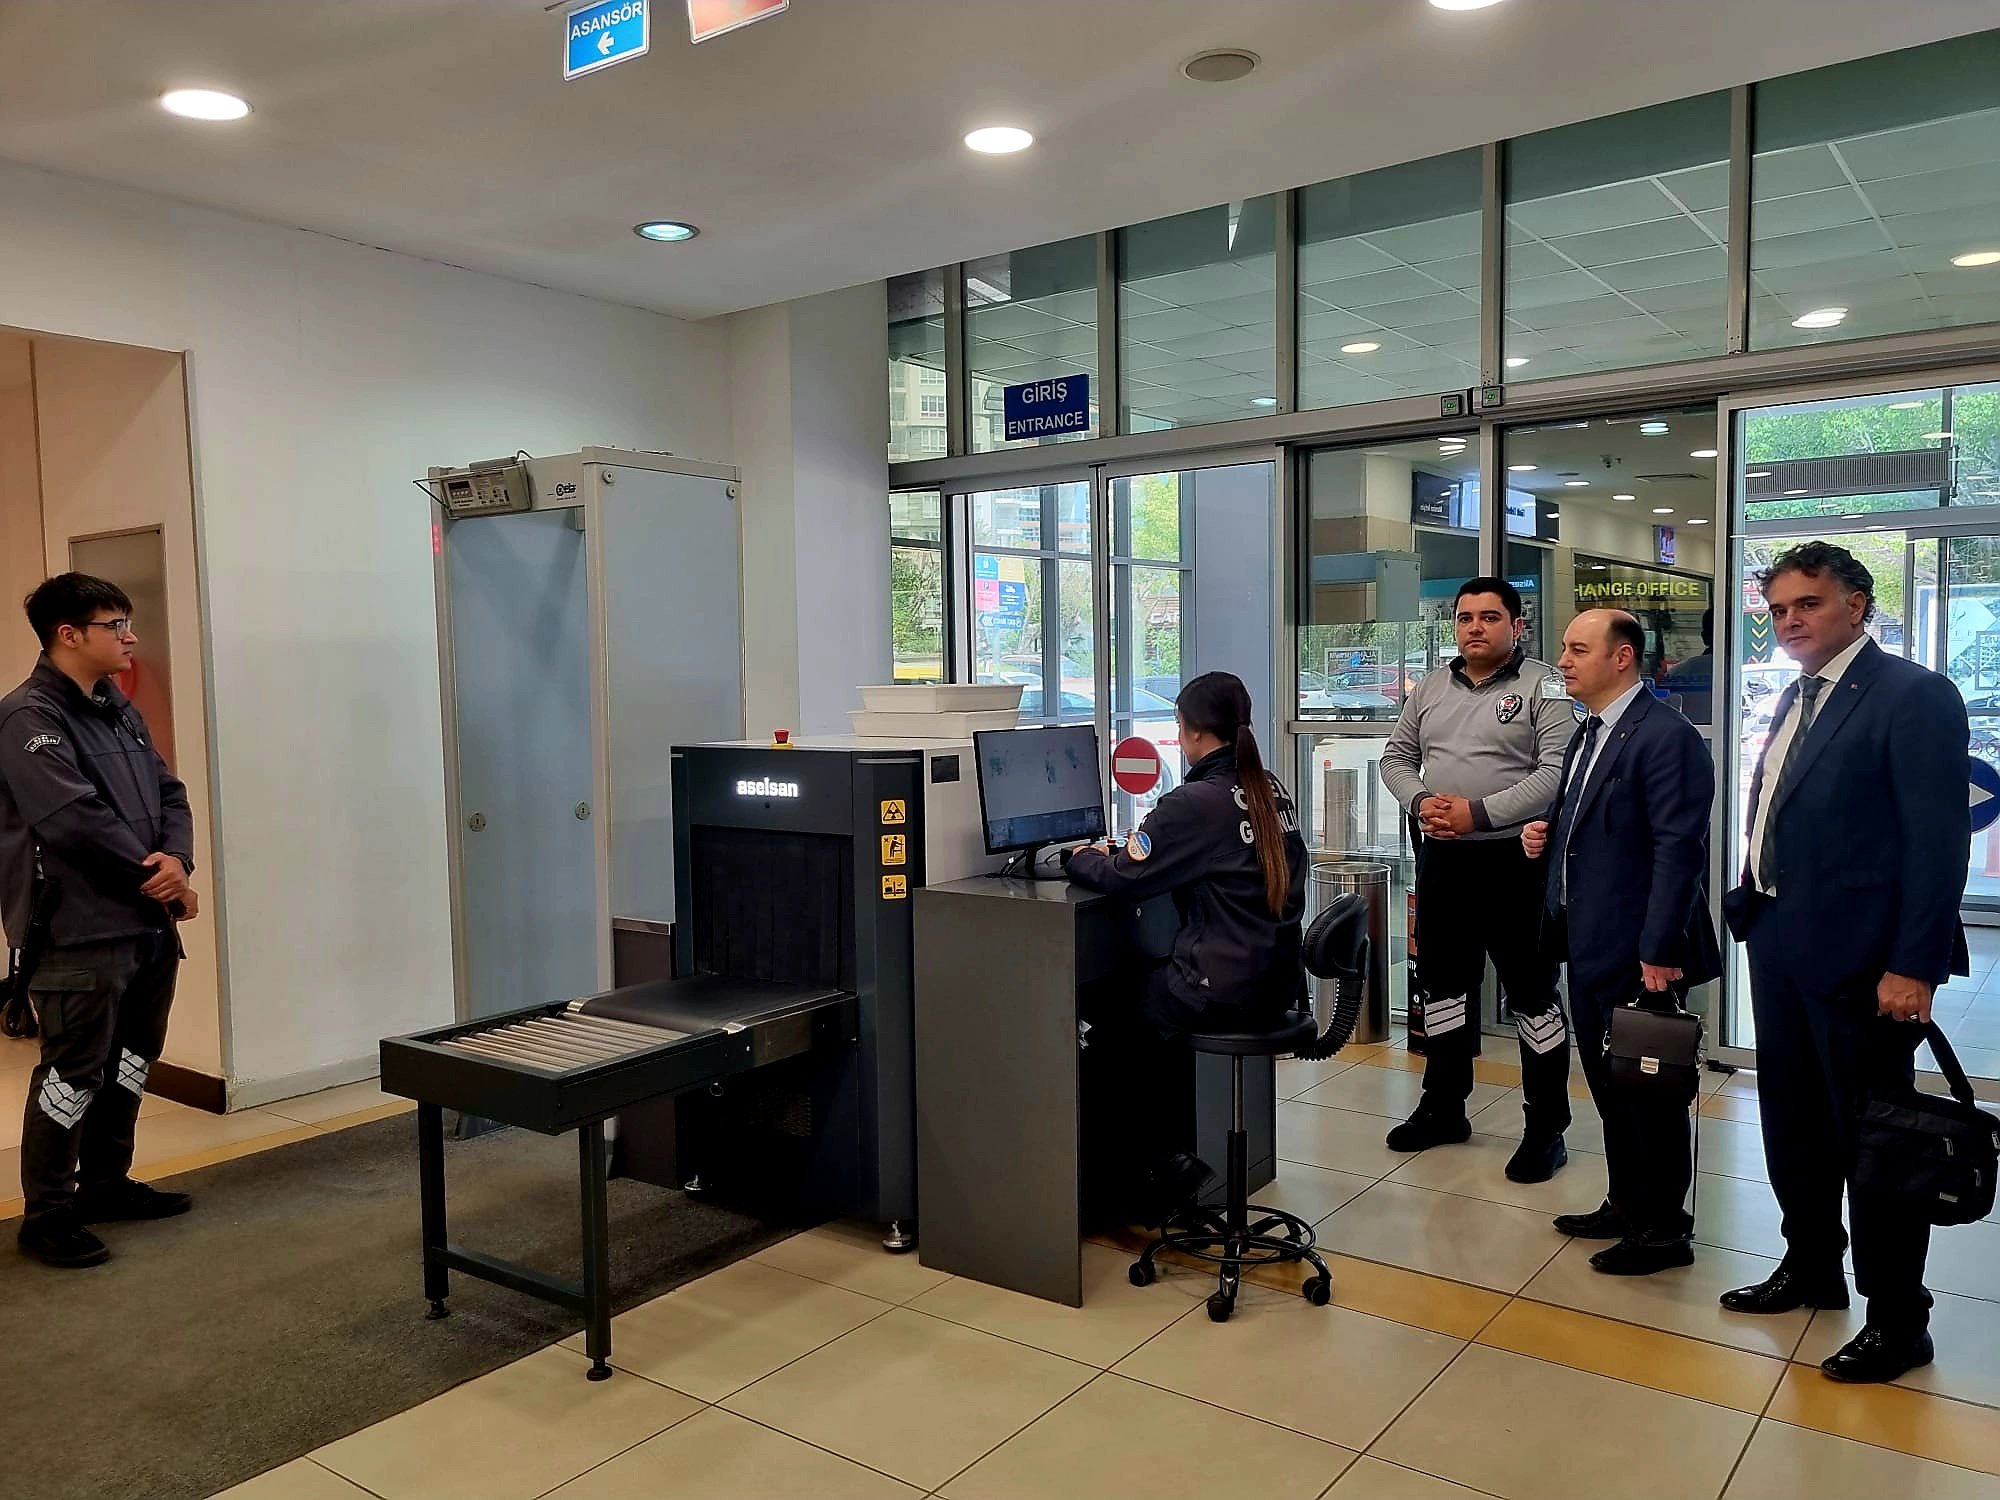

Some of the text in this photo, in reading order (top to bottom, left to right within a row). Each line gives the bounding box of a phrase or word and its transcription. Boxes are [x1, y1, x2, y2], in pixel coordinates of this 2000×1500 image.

[570, 2, 643, 41] ASANSÖR
[1022, 380, 1068, 403] GİRİŞ
[1008, 411, 1084, 435] ENTRANCE
[1636, 582, 1700, 596] OFFICE
[737, 776, 799, 798] aselsan
